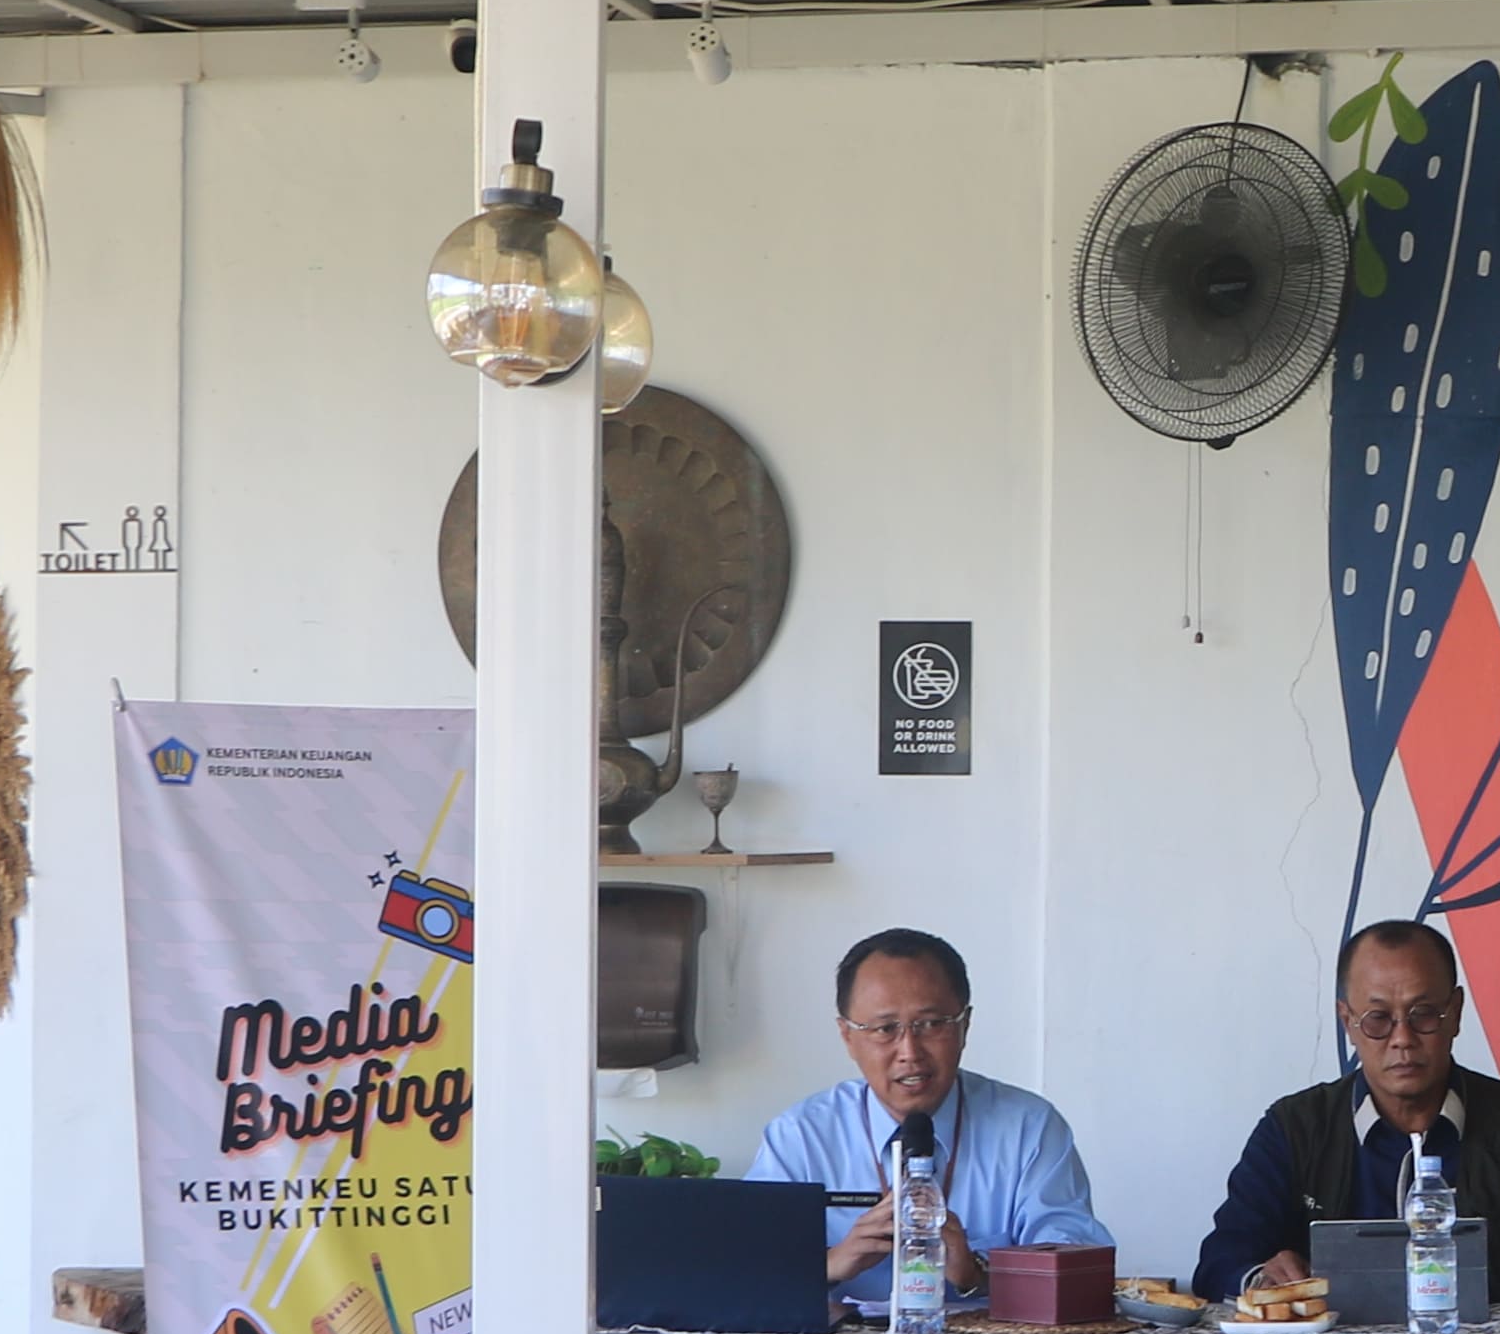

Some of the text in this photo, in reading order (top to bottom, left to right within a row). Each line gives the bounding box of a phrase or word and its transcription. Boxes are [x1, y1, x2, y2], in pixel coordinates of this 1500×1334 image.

[40, 553, 120, 571] TOILET
[895, 719, 955, 729] NO FOOD
[894, 731, 956, 741] OR DRINK
[206, 747, 372, 762] KEMENTERIAN KEUANGAN
[893, 743, 957, 753] ALLOWED
[207, 765, 344, 779] REPUBLIK INDONESIA
[216, 982, 440, 1081] Media
[220, 1058, 473, 1159] Briefing
[180, 1177, 378, 1202] KEMENKEU
[218, 1204, 450, 1230] BUKITTINGGI
[429, 1298, 473, 1334] NEW
